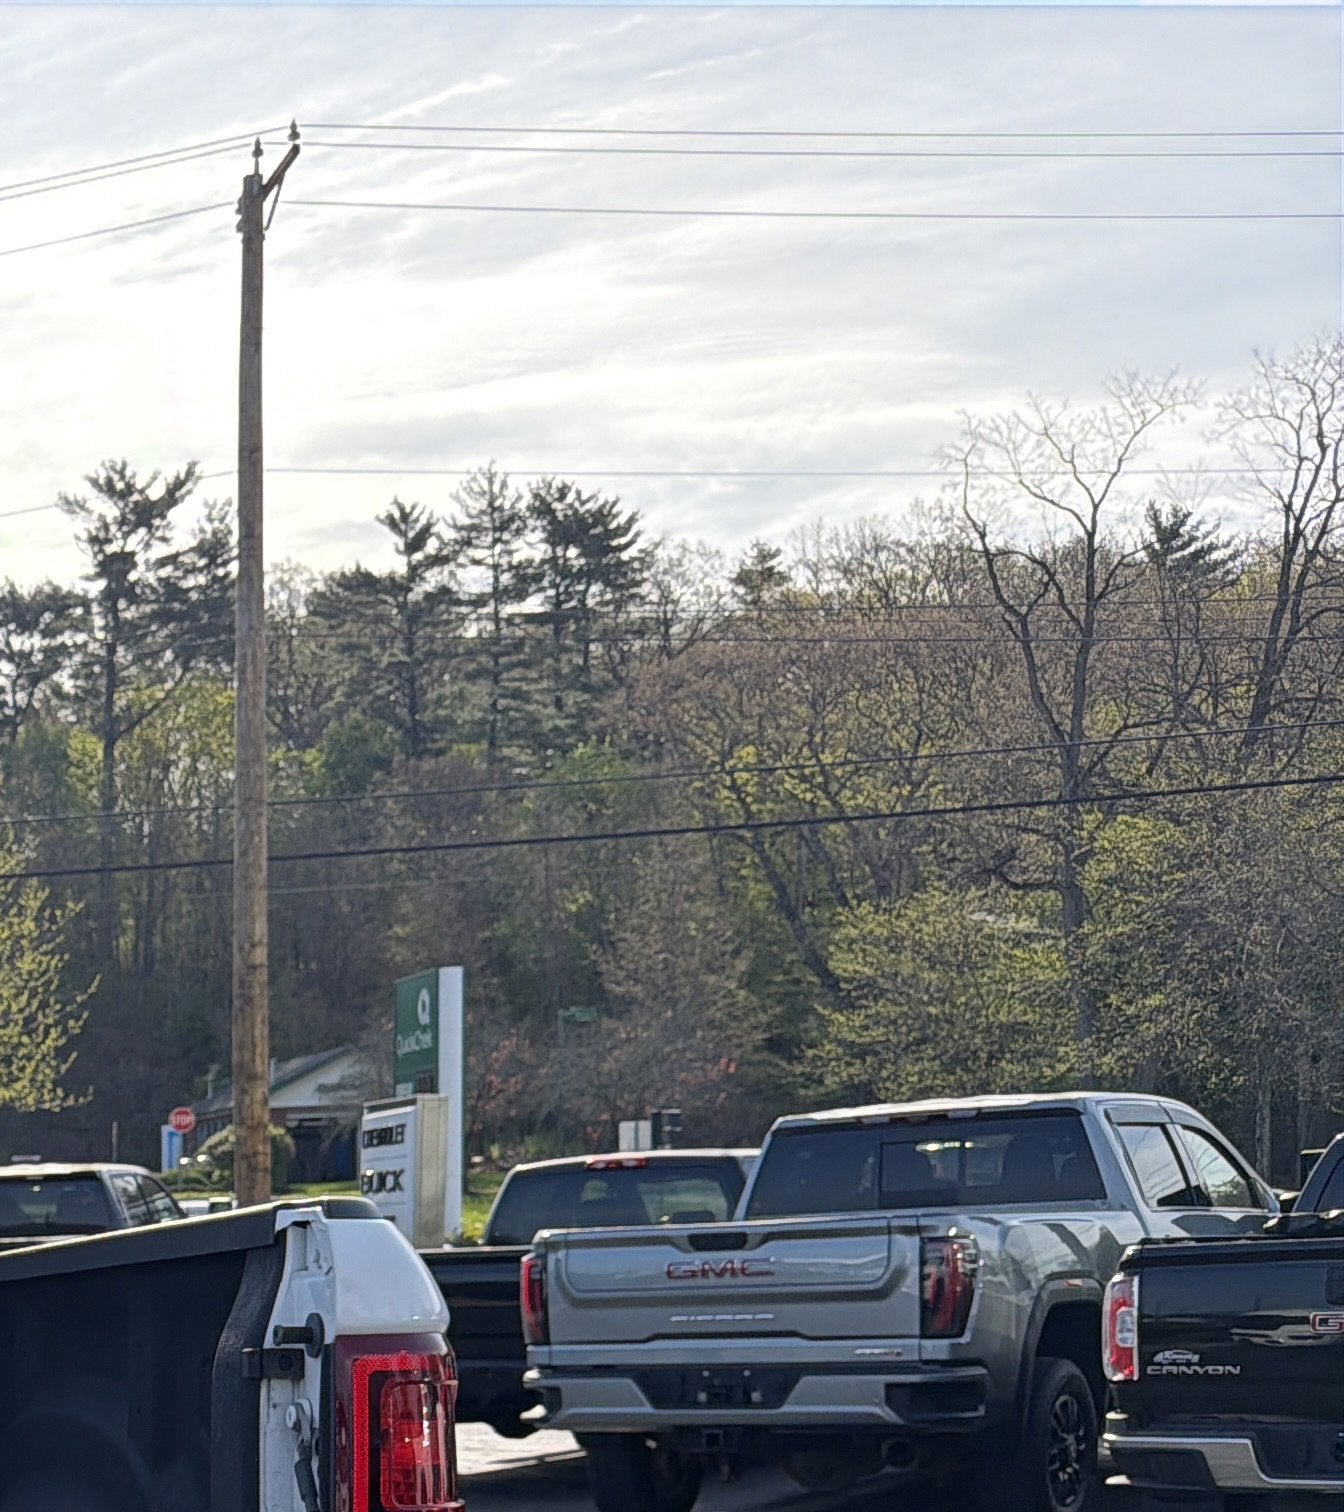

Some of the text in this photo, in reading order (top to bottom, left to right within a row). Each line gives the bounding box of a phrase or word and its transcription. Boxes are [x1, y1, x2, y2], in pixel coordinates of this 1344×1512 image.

[361, 1168, 405, 1195] BUICK
[666, 1256, 776, 1280] GMC
[1146, 1365, 1241, 1375] CANYON
